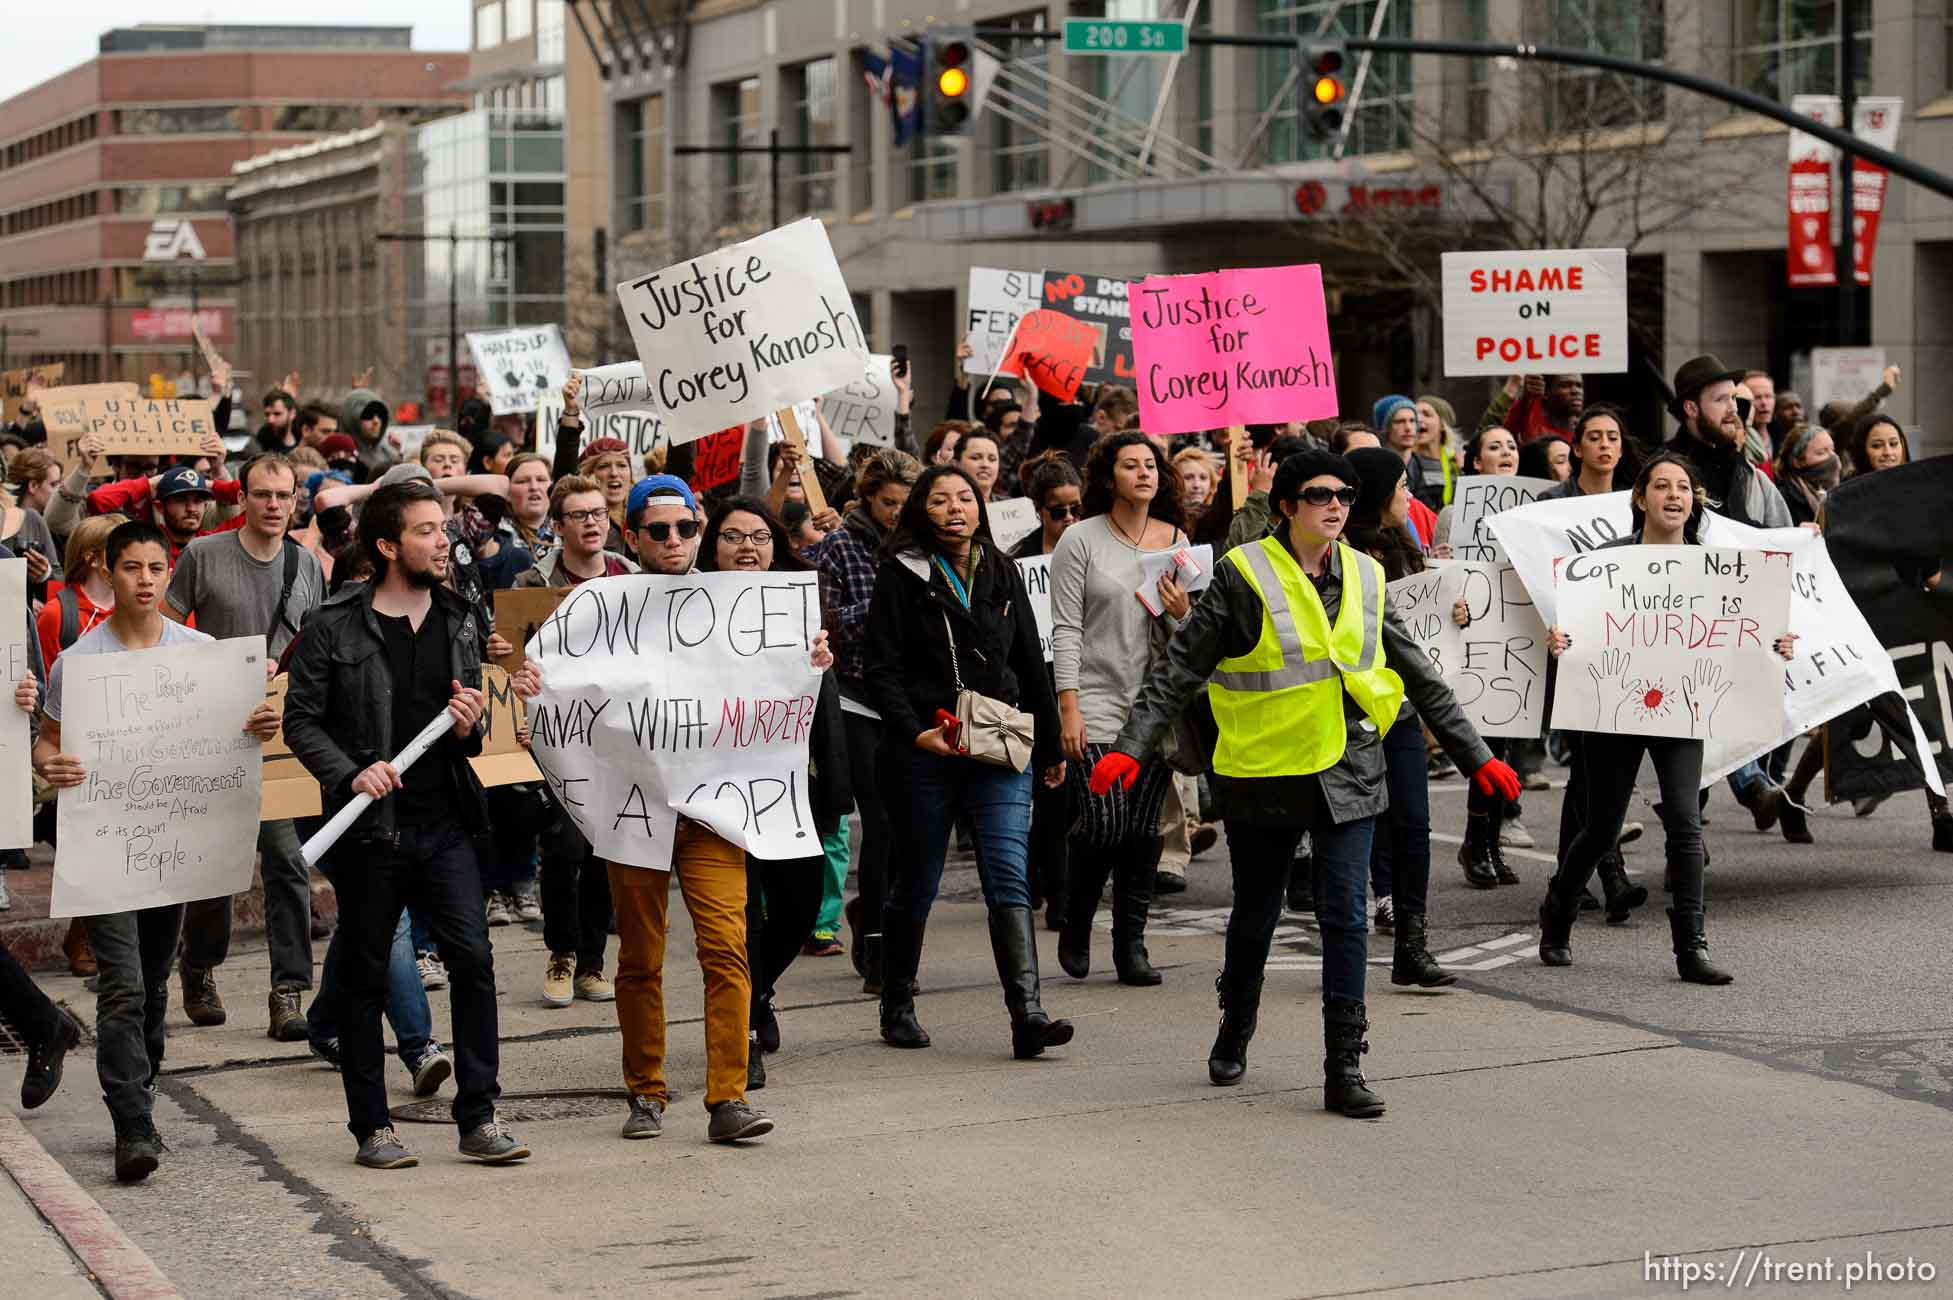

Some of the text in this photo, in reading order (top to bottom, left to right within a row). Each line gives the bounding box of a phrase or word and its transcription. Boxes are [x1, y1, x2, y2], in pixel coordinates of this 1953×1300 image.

[1086, 25, 1127, 47] 200
[143, 219, 207, 259] EA
[632, 256, 771, 330] Justice
[1045, 274, 1085, 303] NO
[1469, 266, 1584, 293] SHAME
[1142, 287, 1266, 329] Justice
[1519, 301, 1551, 318] ON
[703, 309, 747, 344] for
[1208, 323, 1249, 353] for
[659, 361, 749, 409] Corey
[750, 296, 862, 372] Kanosh
[1476, 333, 1601, 362] POLICE
[1150, 363, 1229, 410] Corey
[1237, 346, 1329, 389] Kanosh
[106, 400, 180, 413] UTAH
[92, 419, 207, 433] POLICE
[1565, 516, 1618, 553] NO
[1565, 552, 1749, 589] Cop or Not,
[1621, 583, 1743, 616] Murder is
[664, 586, 716, 648] TO
[727, 582, 817, 657] GET
[1604, 611, 1762, 650] MURDER
[87, 674, 152, 723] The
[530, 697, 611, 748] AWAY
[627, 696, 709, 752] WITH
[123, 801, 155, 812] should
[156, 798, 168, 809] be
[612, 783, 653, 838] A
[96, 826, 109, 837] of
[115, 825, 128, 837] its
